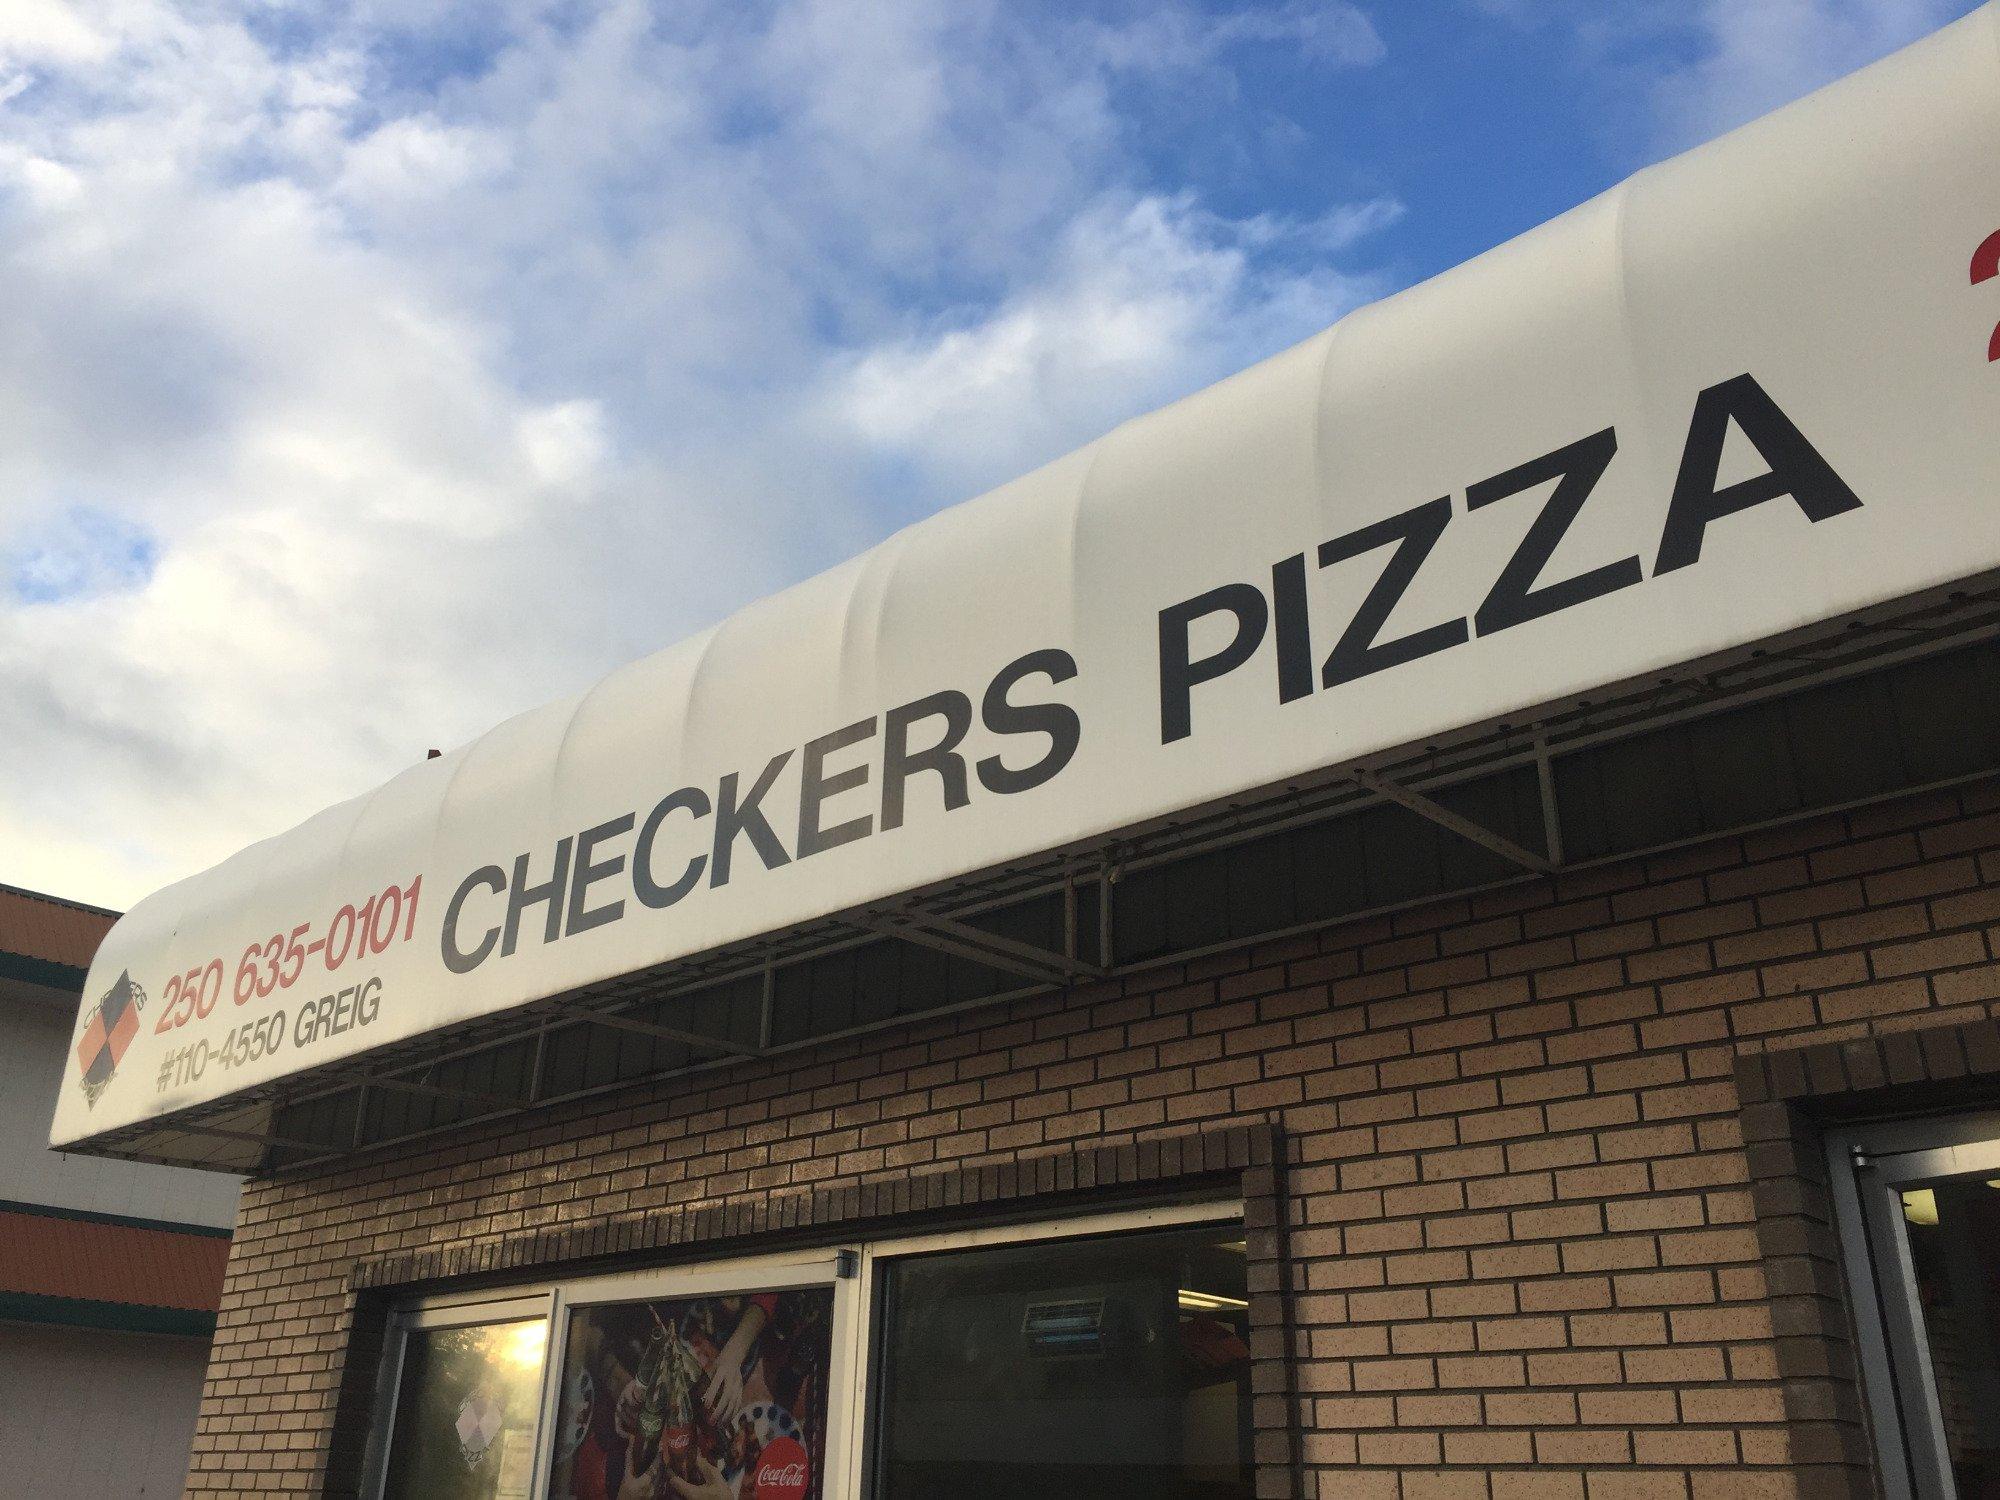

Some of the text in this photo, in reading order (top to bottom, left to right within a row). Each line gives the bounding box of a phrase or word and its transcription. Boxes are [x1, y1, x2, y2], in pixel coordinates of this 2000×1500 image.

[441, 372, 1865, 974] CHECKERS PIZZA
[154, 873, 423, 1035] 250 635-0101
[157, 1010, 286, 1093] #110-4550
[293, 976, 382, 1048] GREIG
[757, 1463, 807, 1487] Coca-Cola
